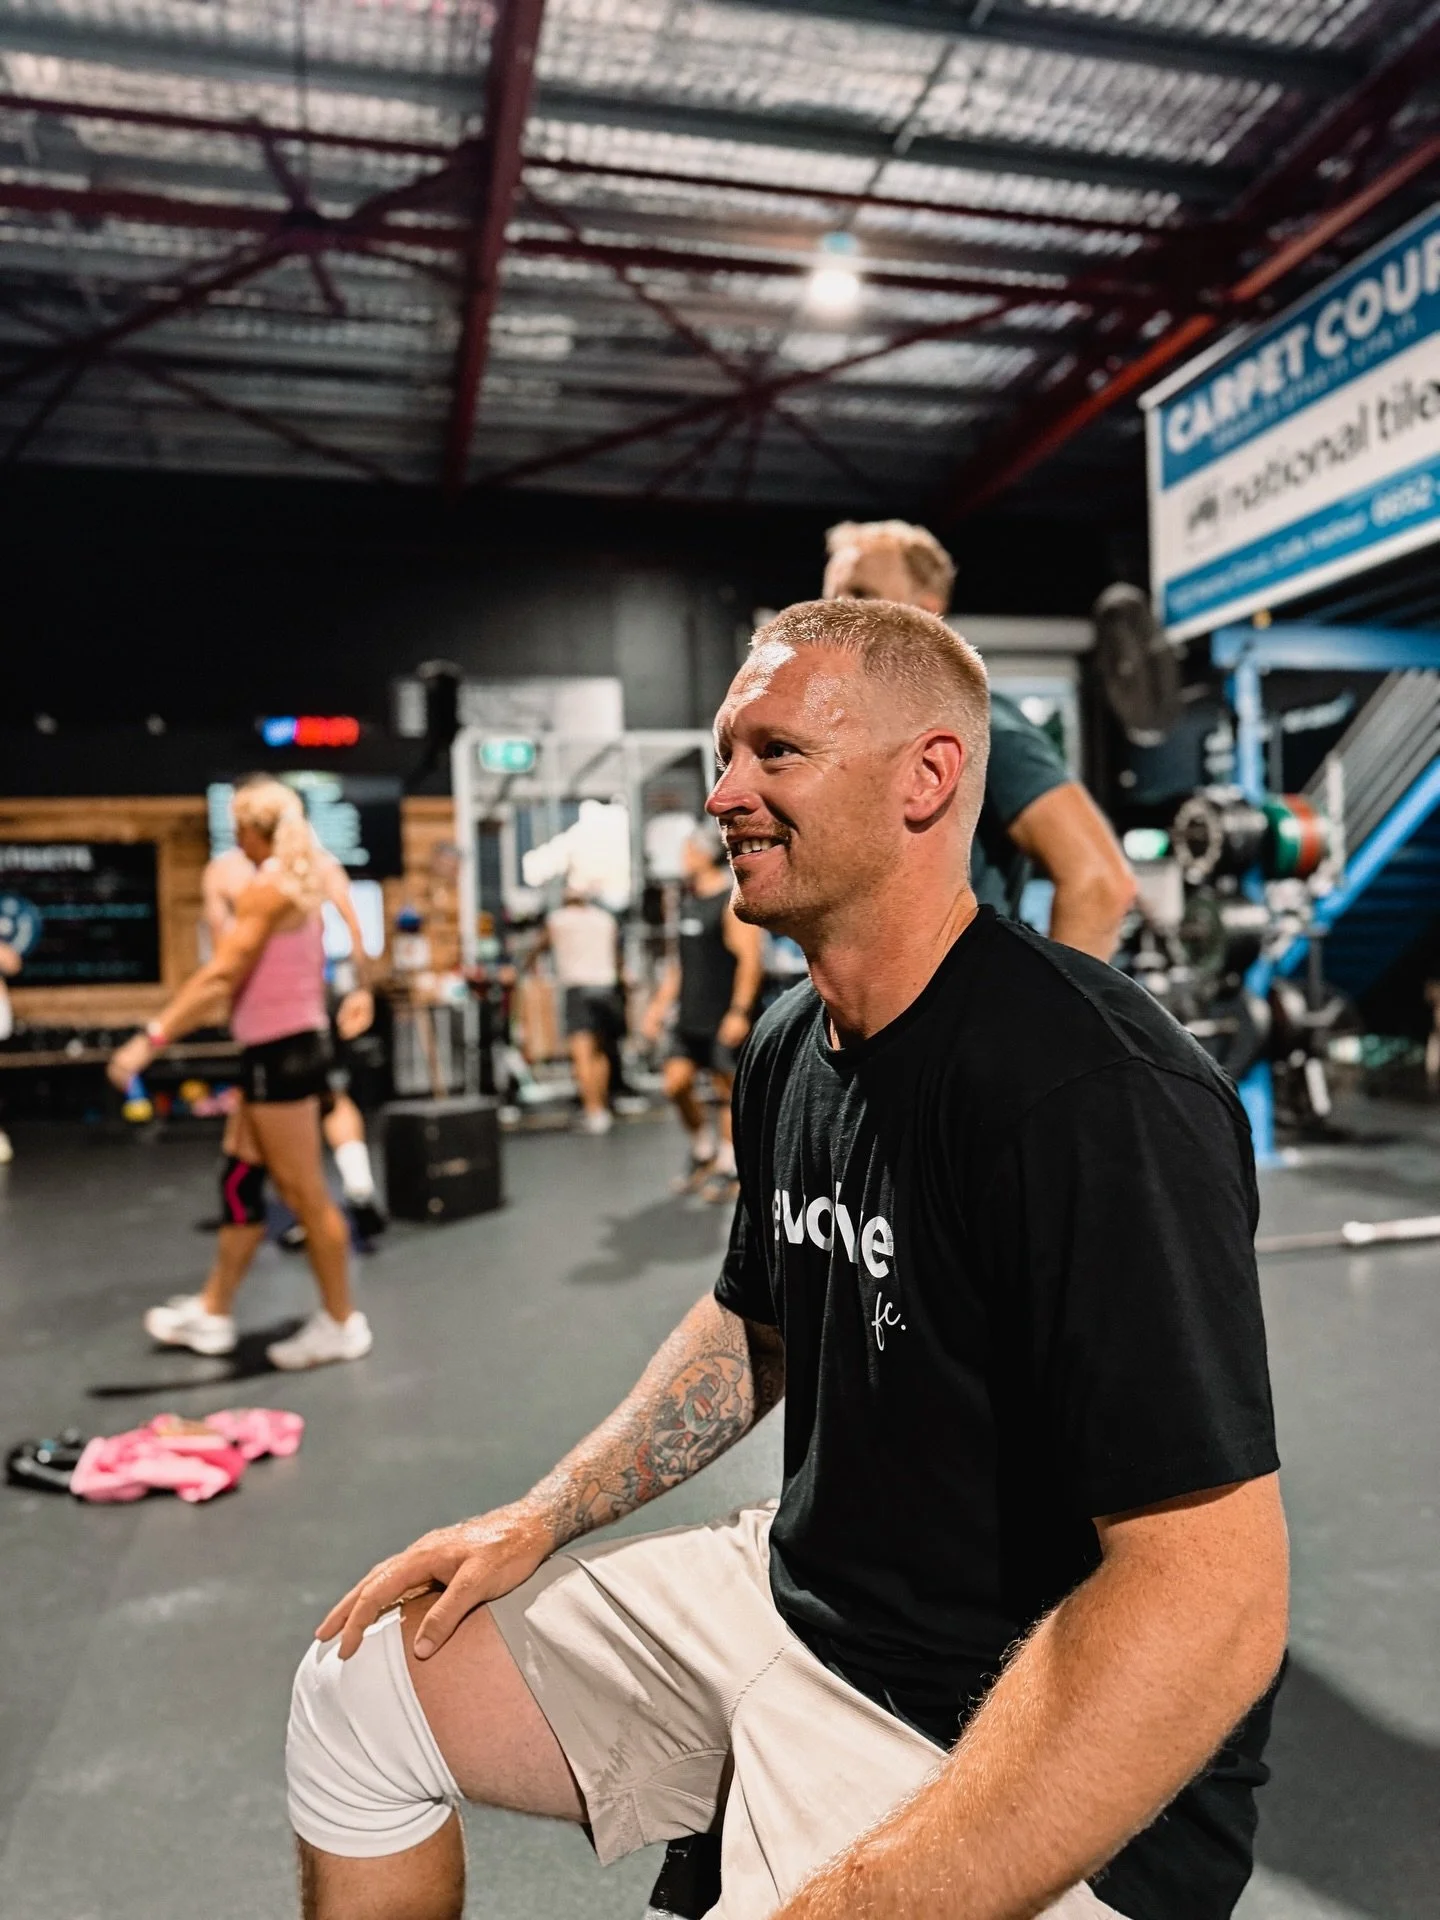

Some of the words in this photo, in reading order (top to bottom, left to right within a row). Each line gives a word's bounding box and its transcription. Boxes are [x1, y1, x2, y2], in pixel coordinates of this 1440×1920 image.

[1167, 322, 1309, 454] CARPET
[1222, 403, 1368, 518] national
[772, 1181, 894, 1278] evove
